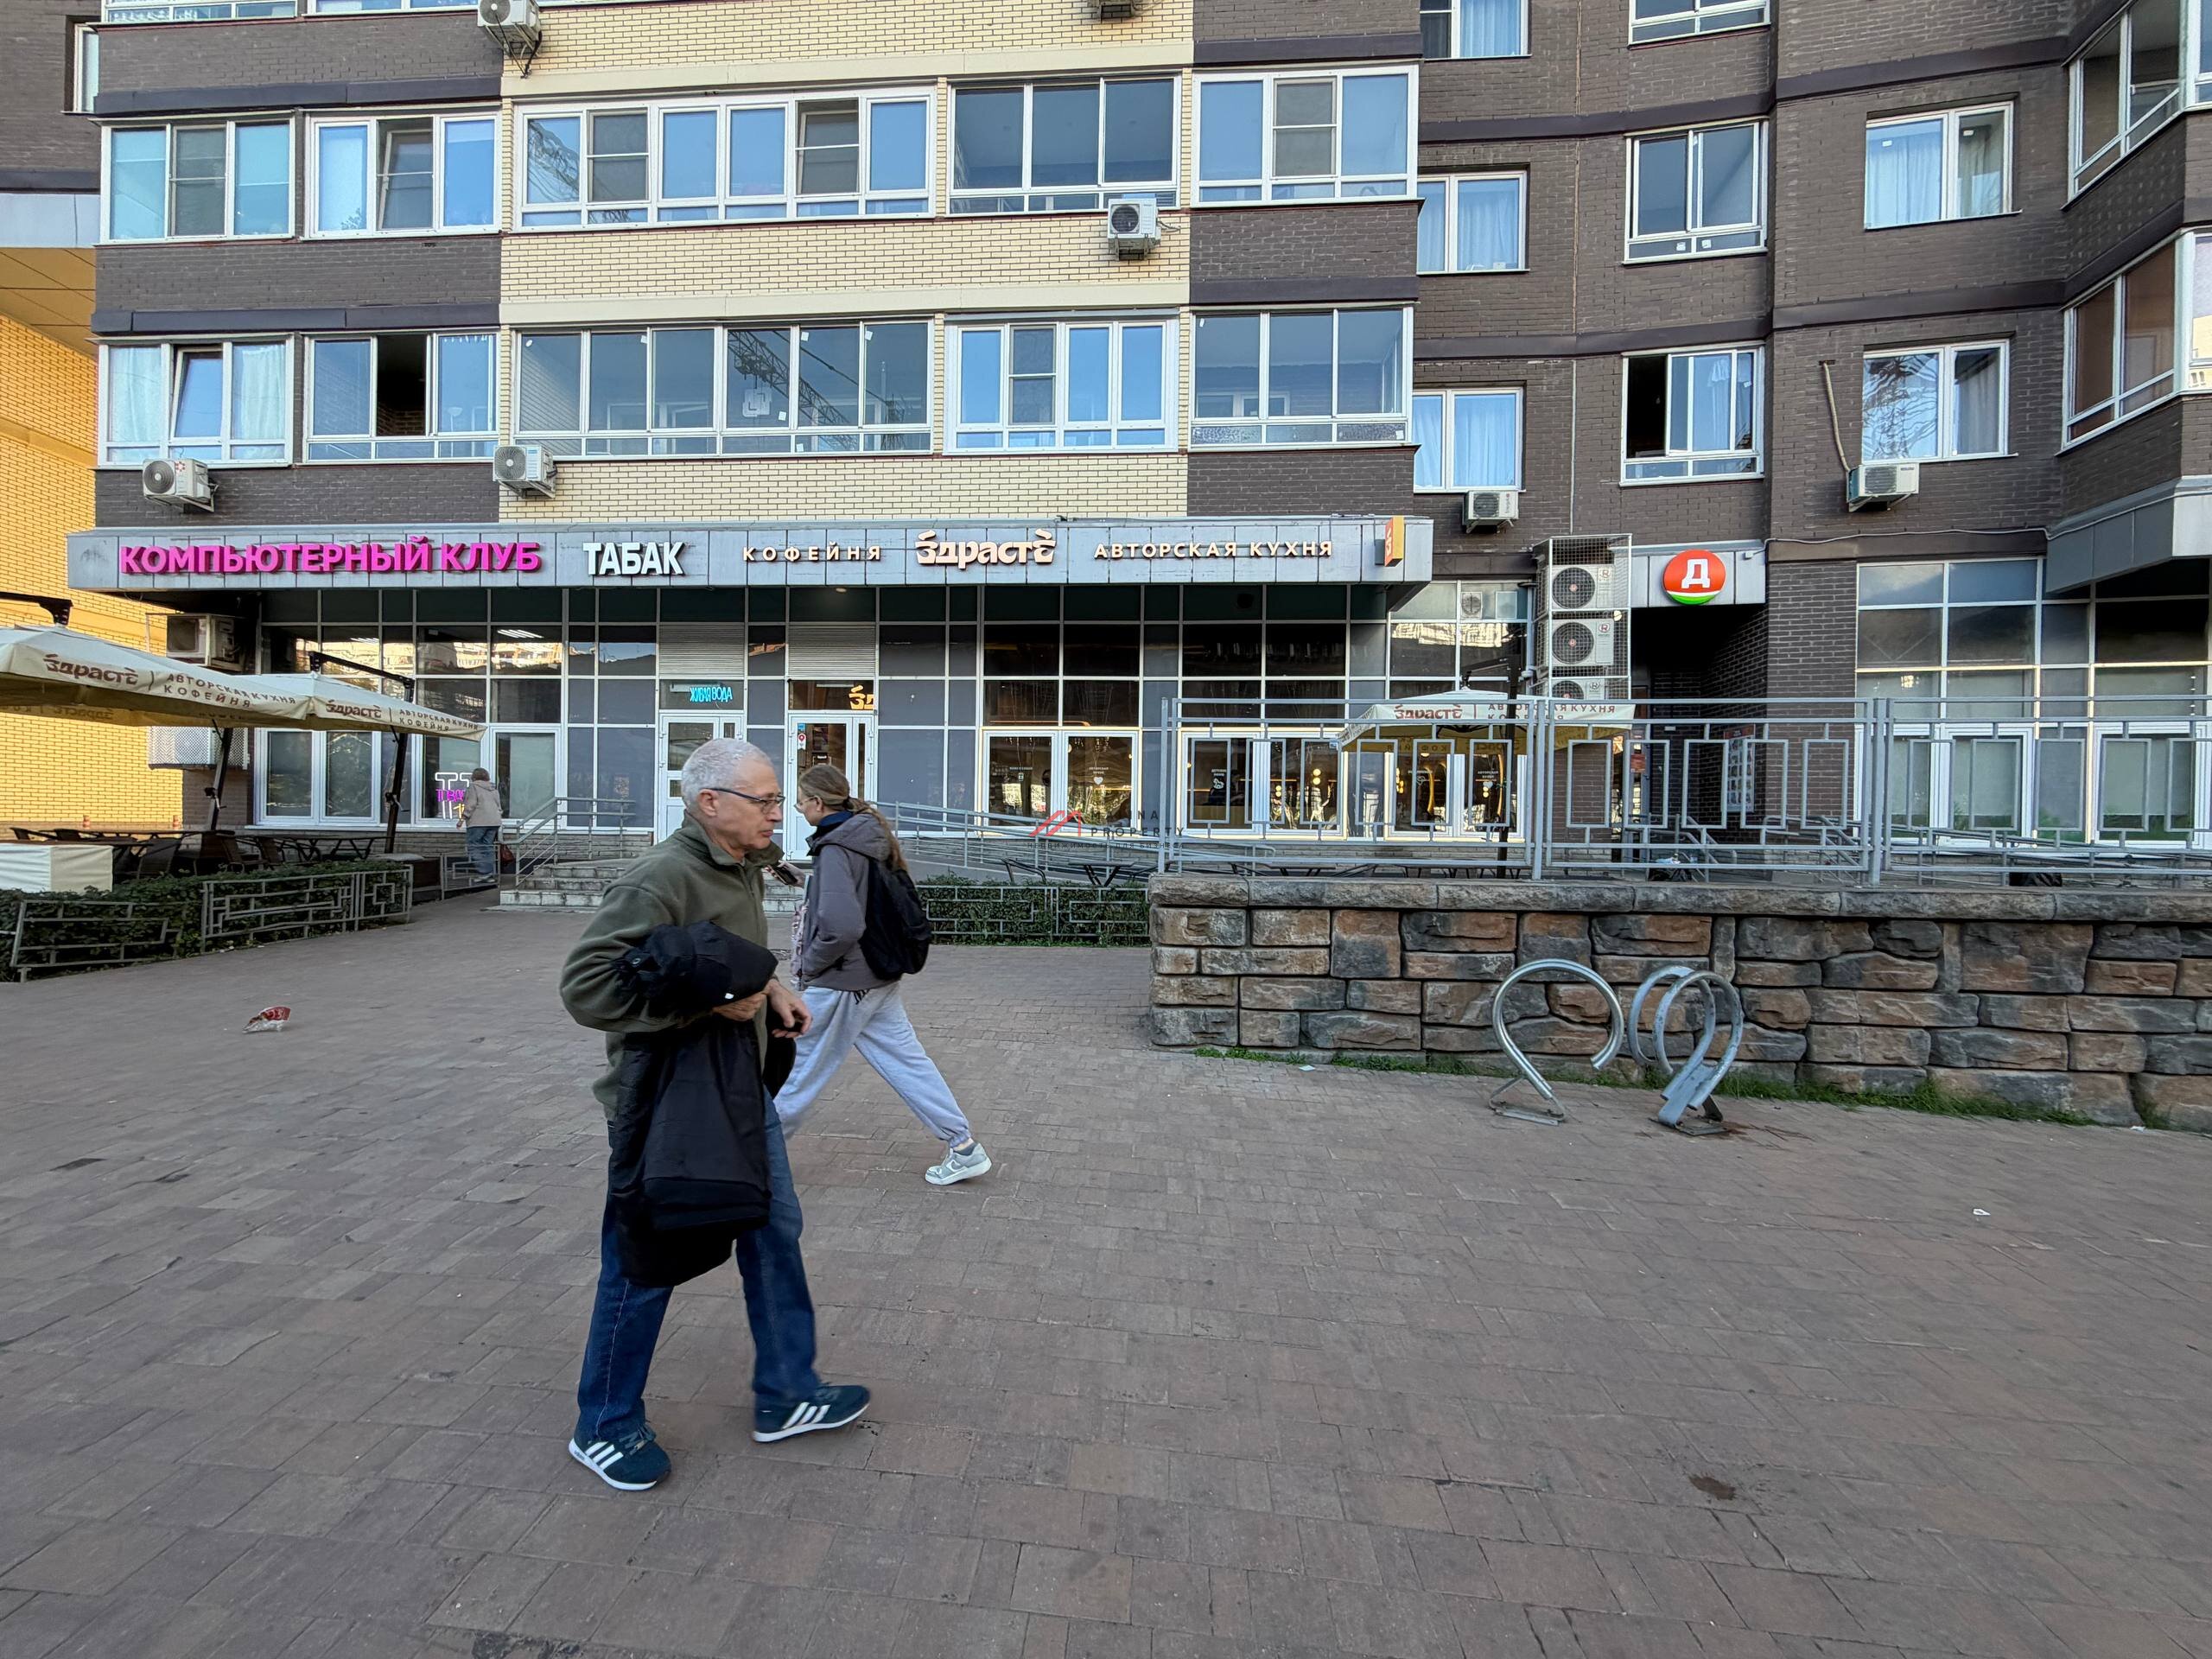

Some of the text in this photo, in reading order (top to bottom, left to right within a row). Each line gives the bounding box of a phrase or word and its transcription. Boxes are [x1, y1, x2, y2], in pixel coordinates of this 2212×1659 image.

[119, 535, 543, 575] КОМПЬЮТЕРНЫЙ КЛУБ
[582, 540, 687, 576] ТАБАК
[742, 541, 882, 563] КОФЕЙНЯ
[1093, 540, 1333, 560] АВТОРСКАЯ КУХНЯ
[1681, 558, 1711, 589] Д
[163, 683, 252, 709] КОФЕЙНЯ
[166, 672, 297, 705] АВТОРСКАЯ КУХНЯ
[711, 686, 733, 702] ВОДА
[399, 709, 452, 724] АВТОРСКАЯ
[399, 717, 450, 732] КОФЕЙНЯ
